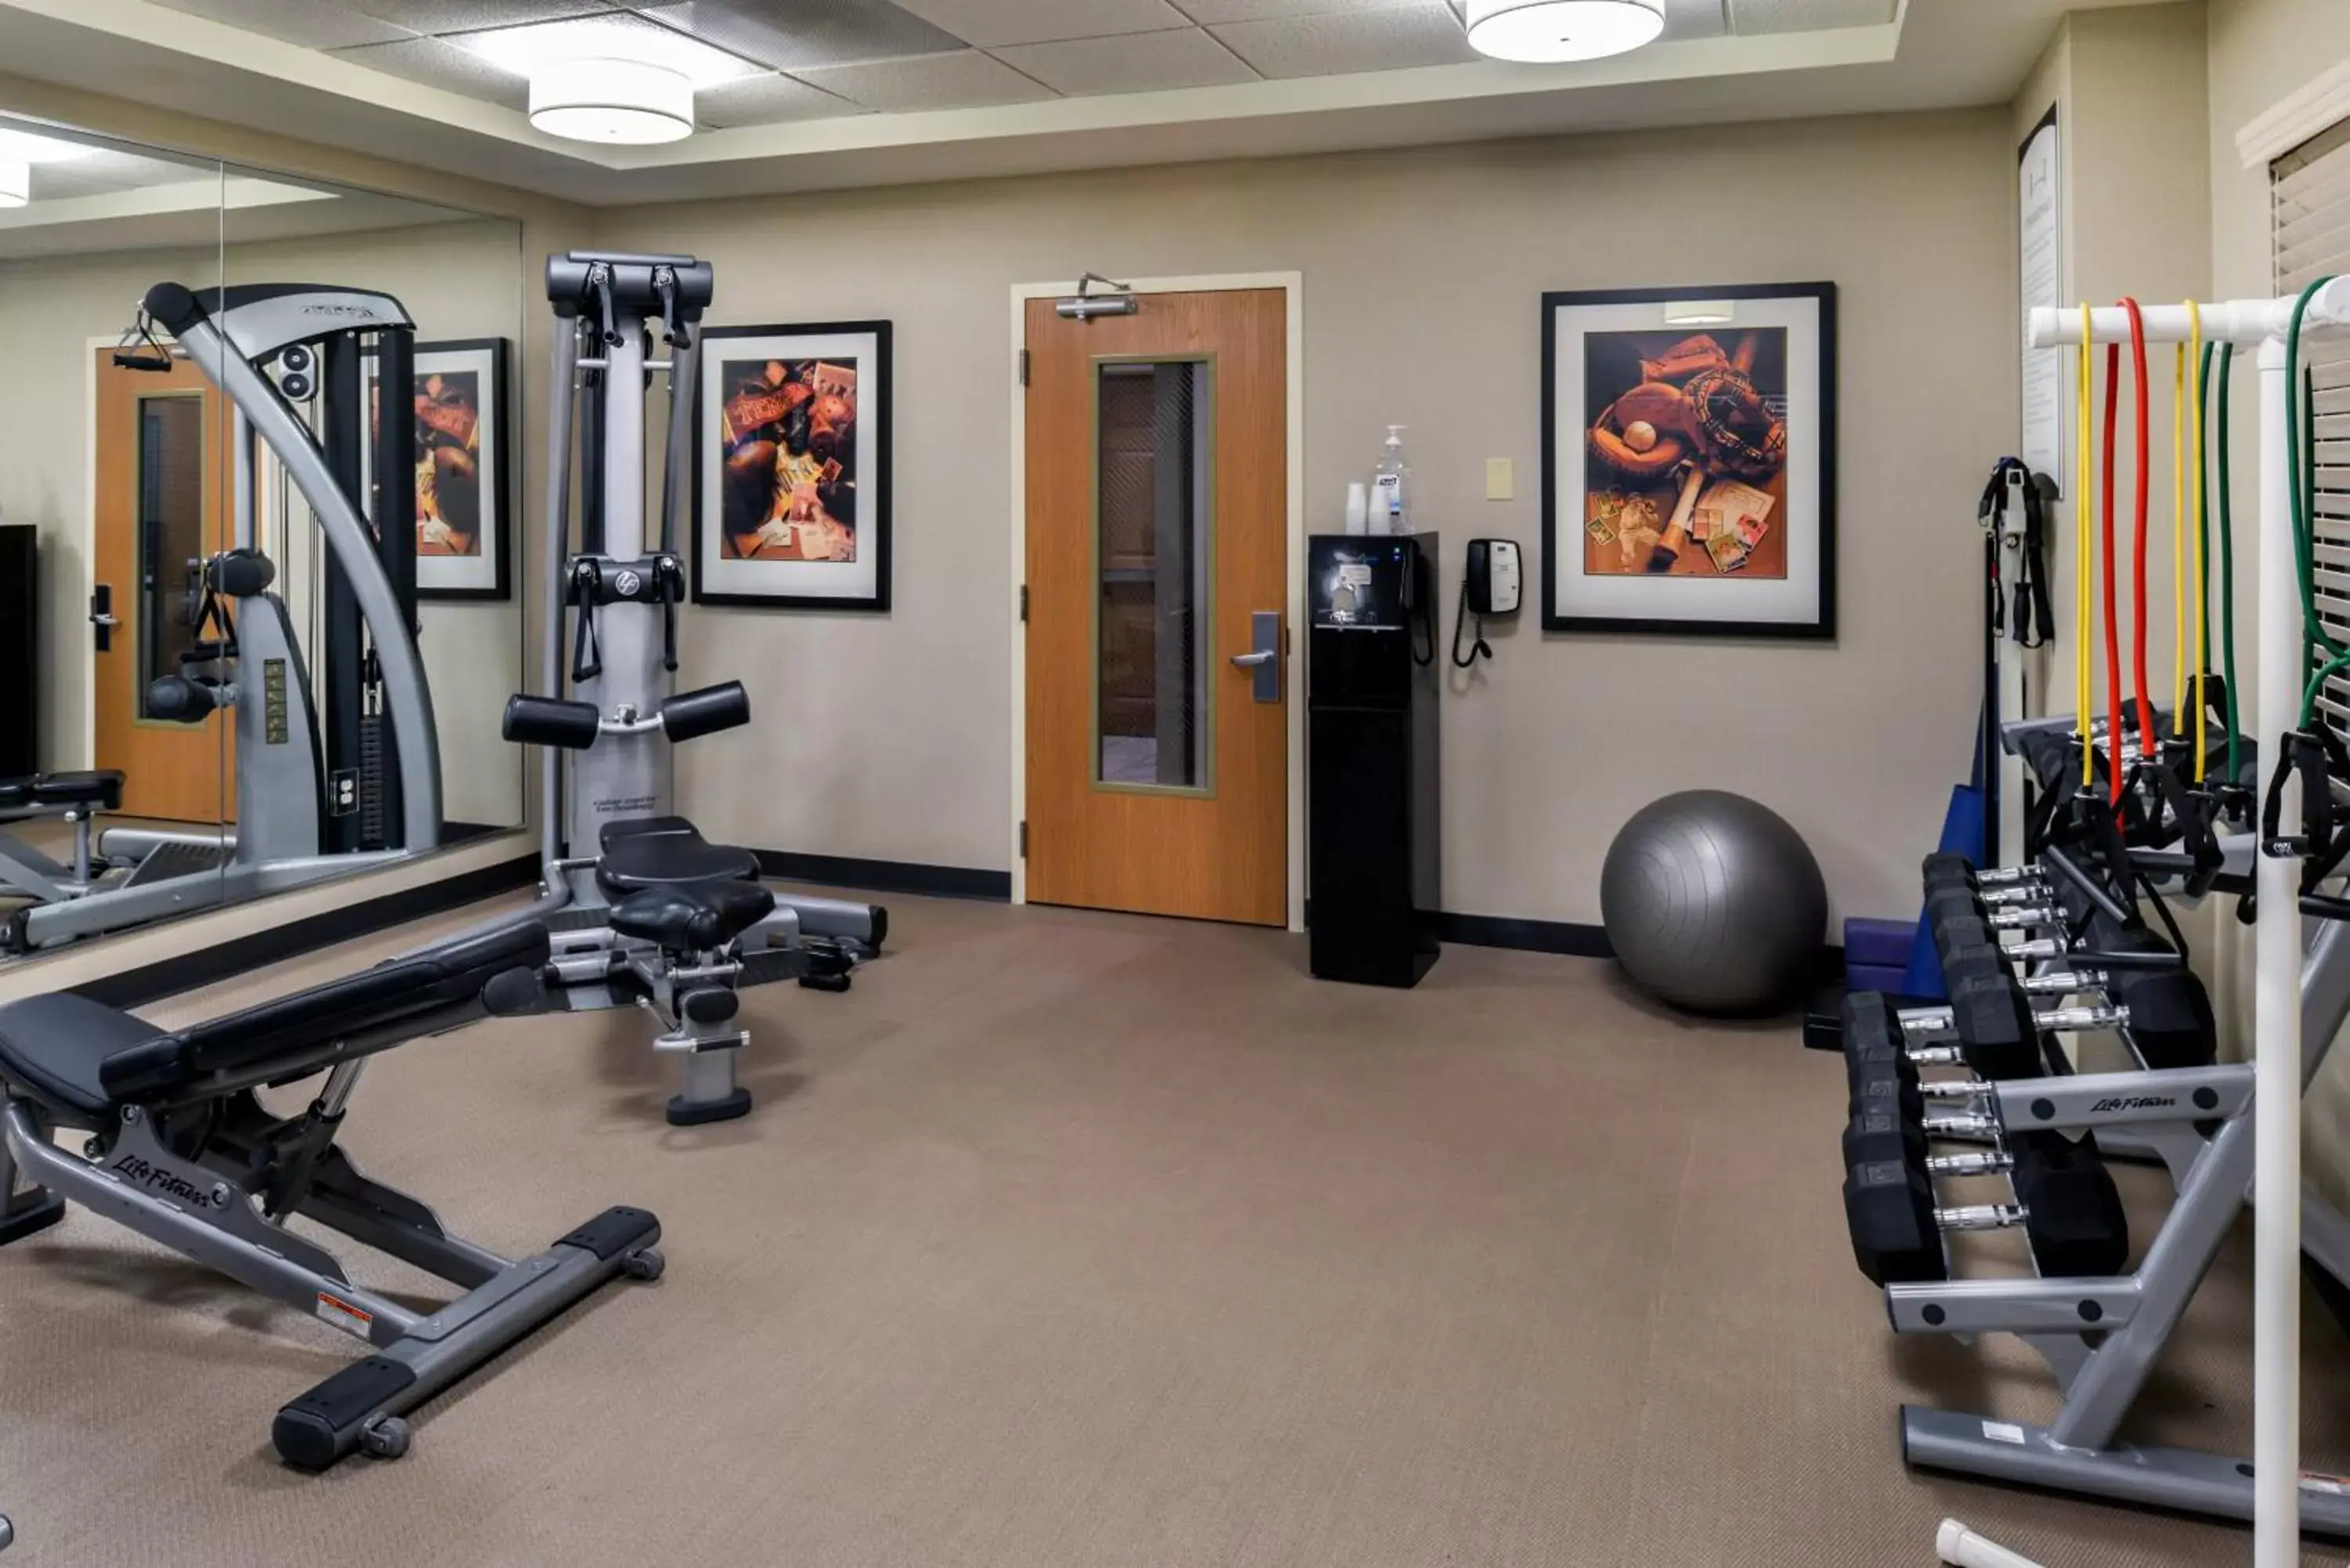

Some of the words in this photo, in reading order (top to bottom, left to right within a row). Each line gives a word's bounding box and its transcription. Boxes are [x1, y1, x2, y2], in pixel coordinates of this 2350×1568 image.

[2090, 1098, 2121, 1112] Life
[112, 1154, 150, 1180] Life
[146, 1168, 210, 1208] Fitness
